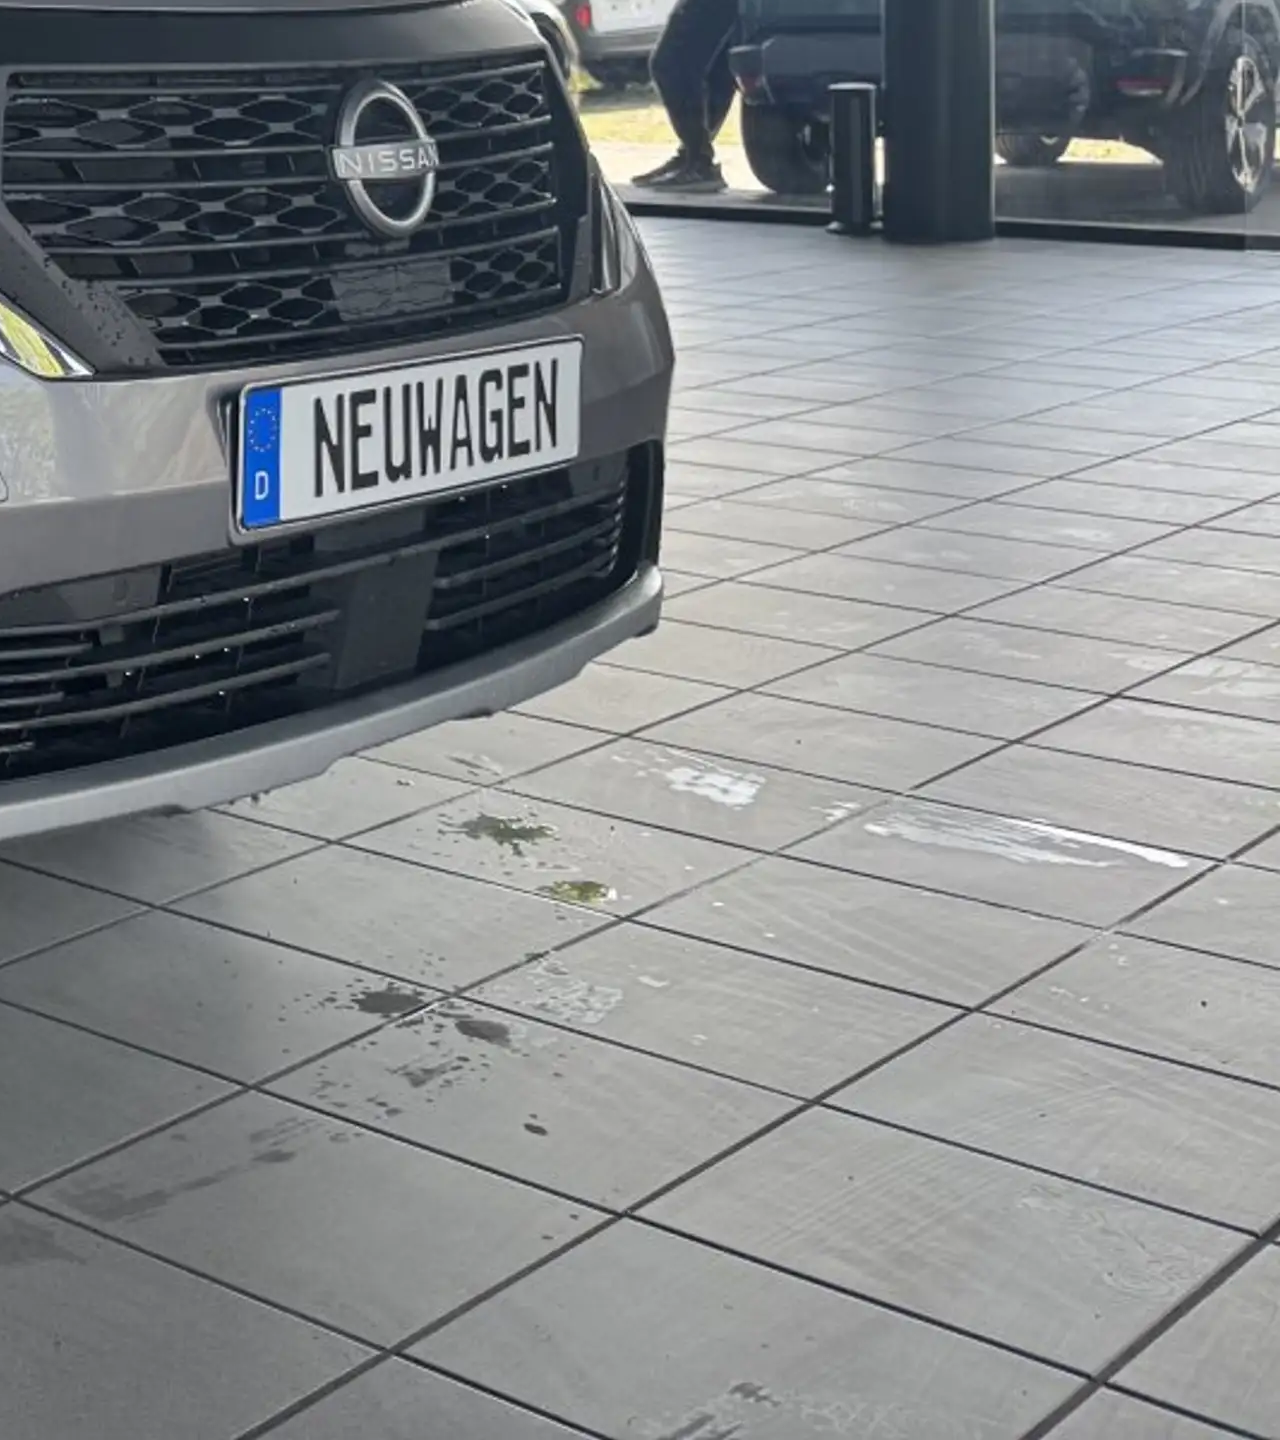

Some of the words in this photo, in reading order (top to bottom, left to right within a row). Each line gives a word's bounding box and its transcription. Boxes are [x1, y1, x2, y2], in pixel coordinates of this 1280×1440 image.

[338, 143, 439, 175] NISSAN
[254, 470, 269, 501] D
[313, 358, 559, 498] NEUWAGEN
